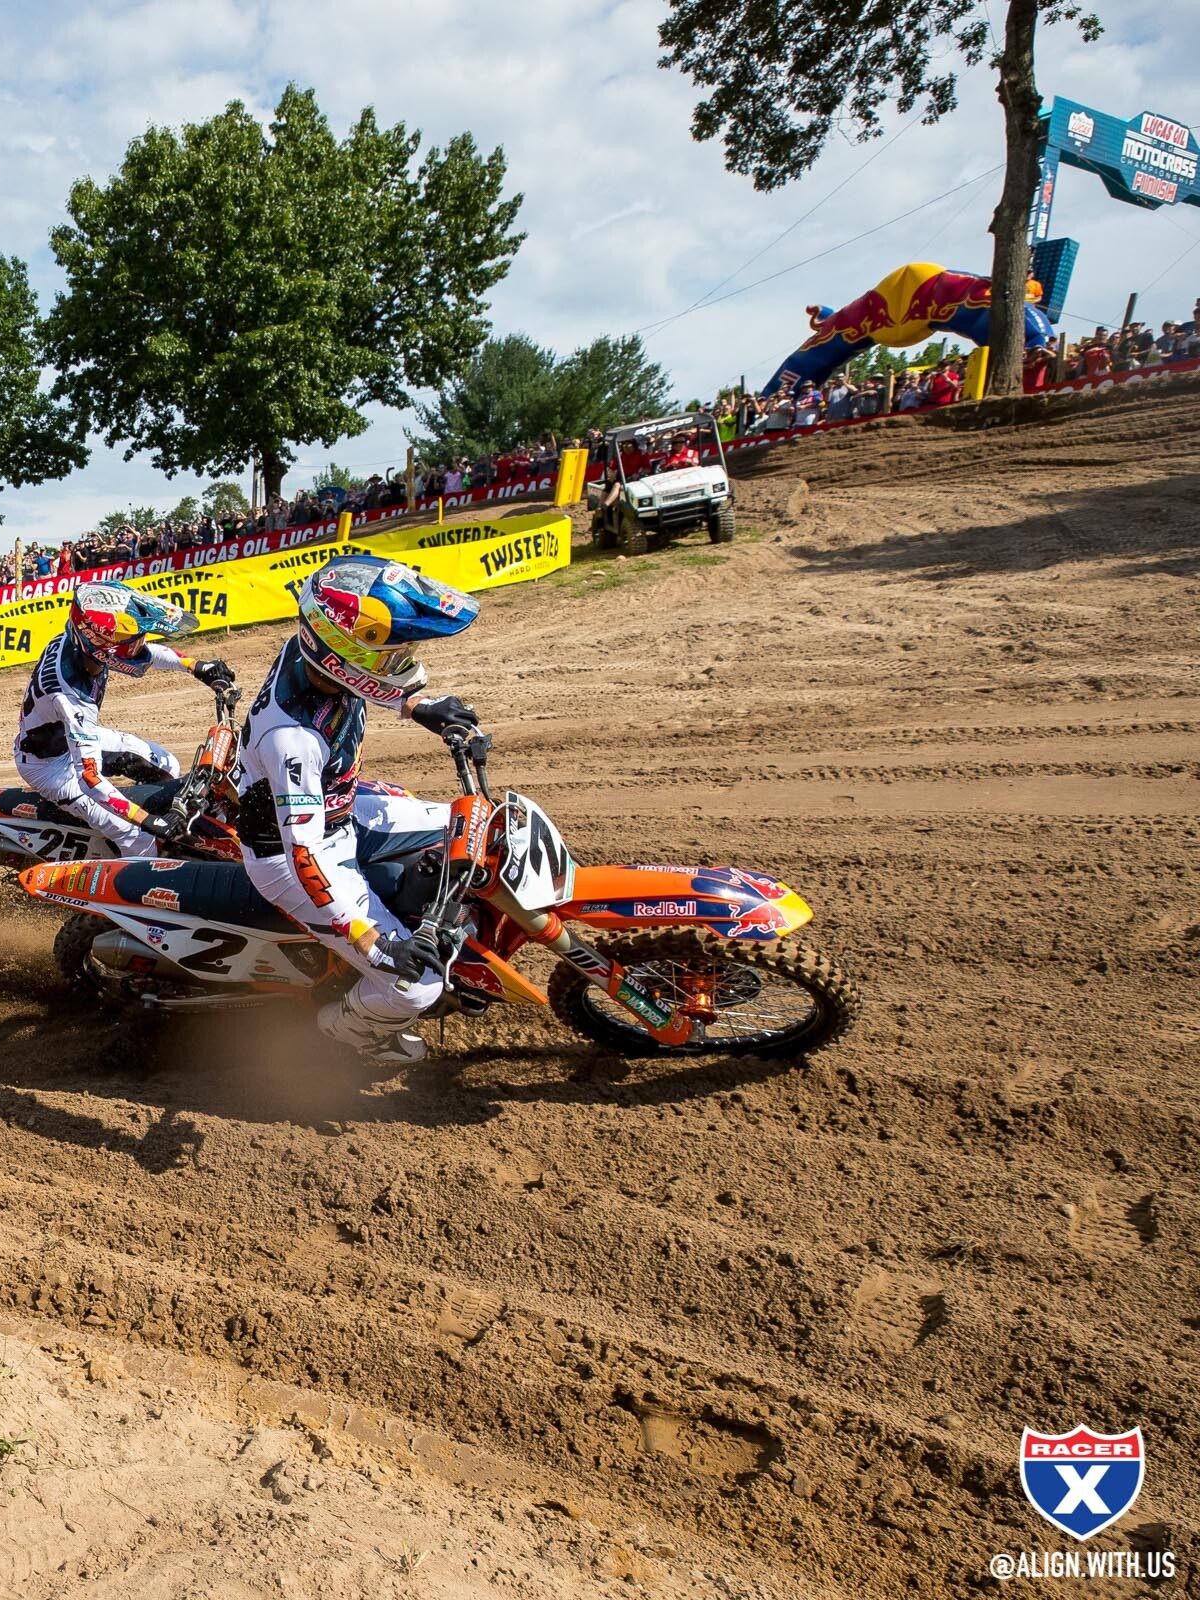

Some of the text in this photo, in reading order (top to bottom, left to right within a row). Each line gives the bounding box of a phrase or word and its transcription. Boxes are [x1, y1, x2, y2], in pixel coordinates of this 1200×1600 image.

[1143, 117, 1173, 141] LUCAS
[1120, 156, 1195, 186] CHAMPIONSHIP
[1121, 138, 1198, 179] MOTOCROSS
[1132, 171, 1178, 202] FINISH
[150, 556, 175, 574] OIL
[184, 536, 271, 569] LUCAS OIL
[187, 588, 228, 617] TEA
[301, 626, 316, 650] BELL
[322, 653, 403, 703] Red Bull
[285, 794, 322, 805] MOTOREX
[35, 828, 92, 862] 25
[292, 843, 335, 908] KTM
[44, 892, 89, 908] DUNLOP
[634, 901, 696, 916] Red Bull
[177, 926, 249, 975] 2
[626, 995, 666, 1027] MOTOREX
